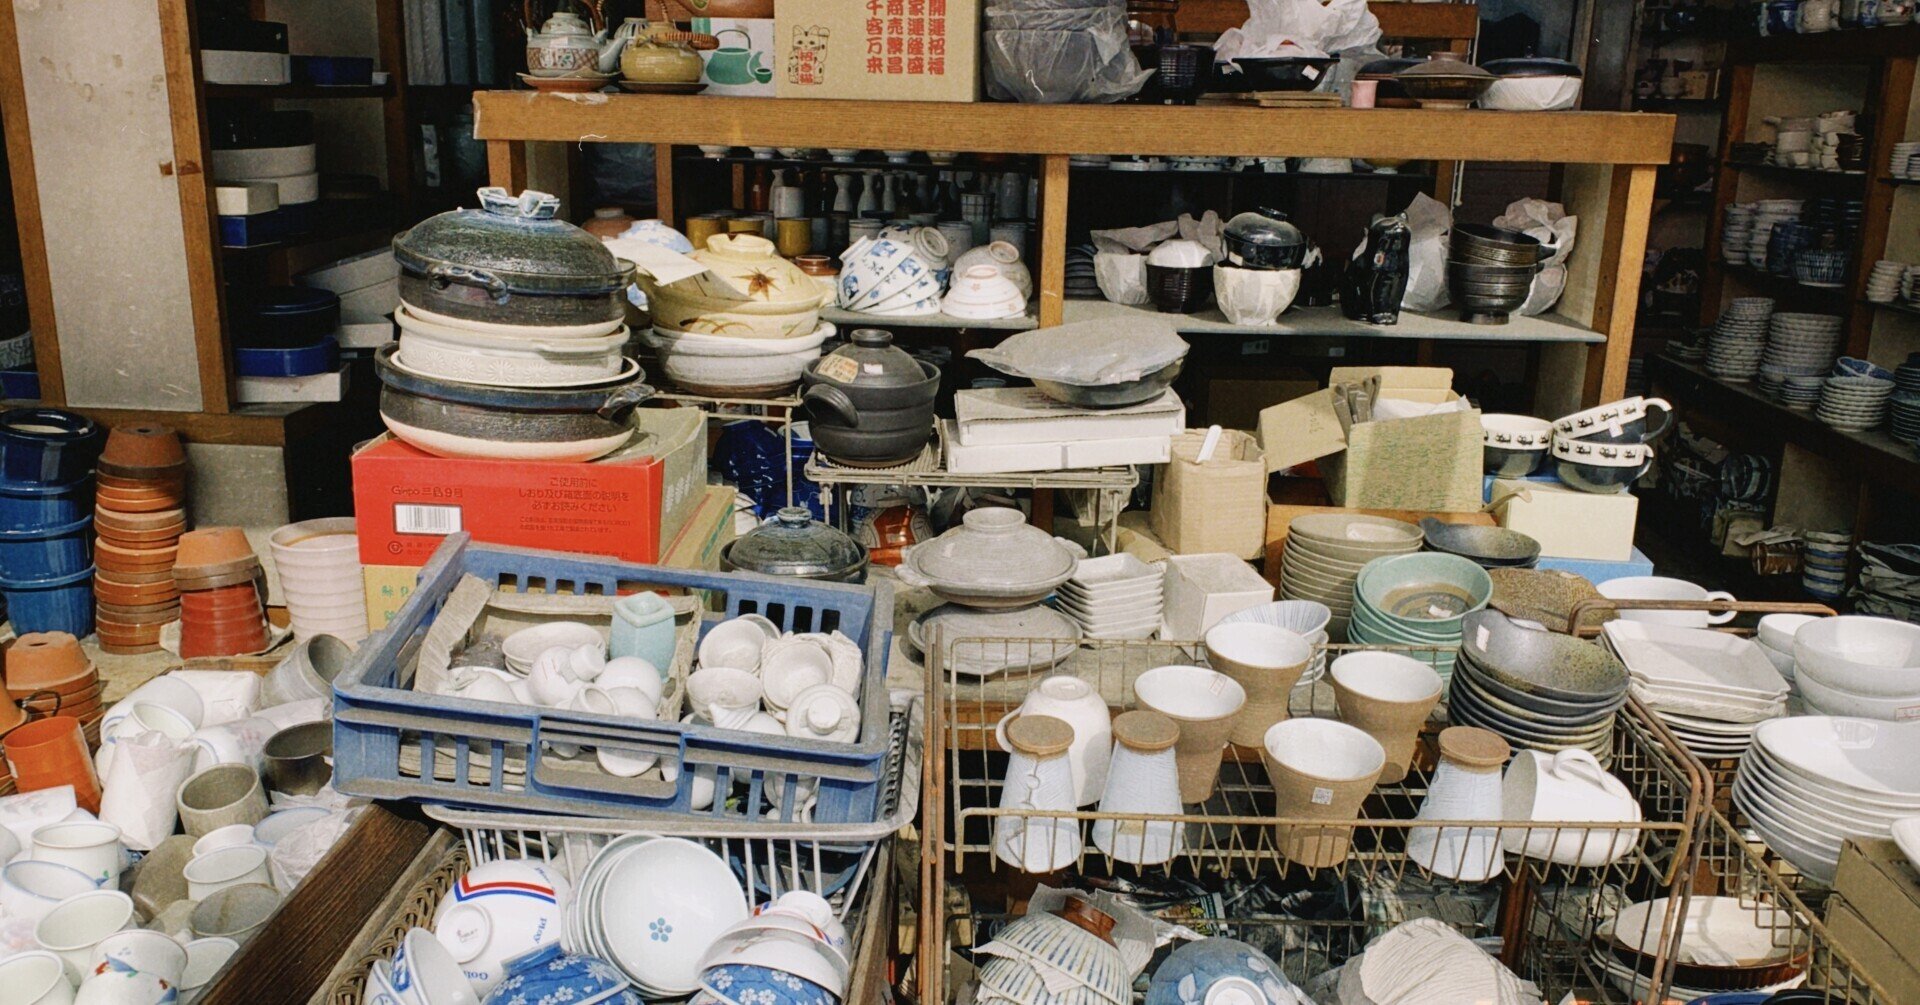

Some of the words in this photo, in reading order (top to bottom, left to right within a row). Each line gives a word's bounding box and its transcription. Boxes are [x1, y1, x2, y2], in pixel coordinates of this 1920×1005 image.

[865, 0, 883, 74] 千客万来
[907, 0, 924, 74] 家運隆盛
[928, 0, 946, 75] 開運招福
[799, 51, 814, 83] 招き猫
[550, 477, 598, 488] ご使用前に
[531, 500, 617, 512] 必ずお読みください
[533, 918, 547, 944] Play
